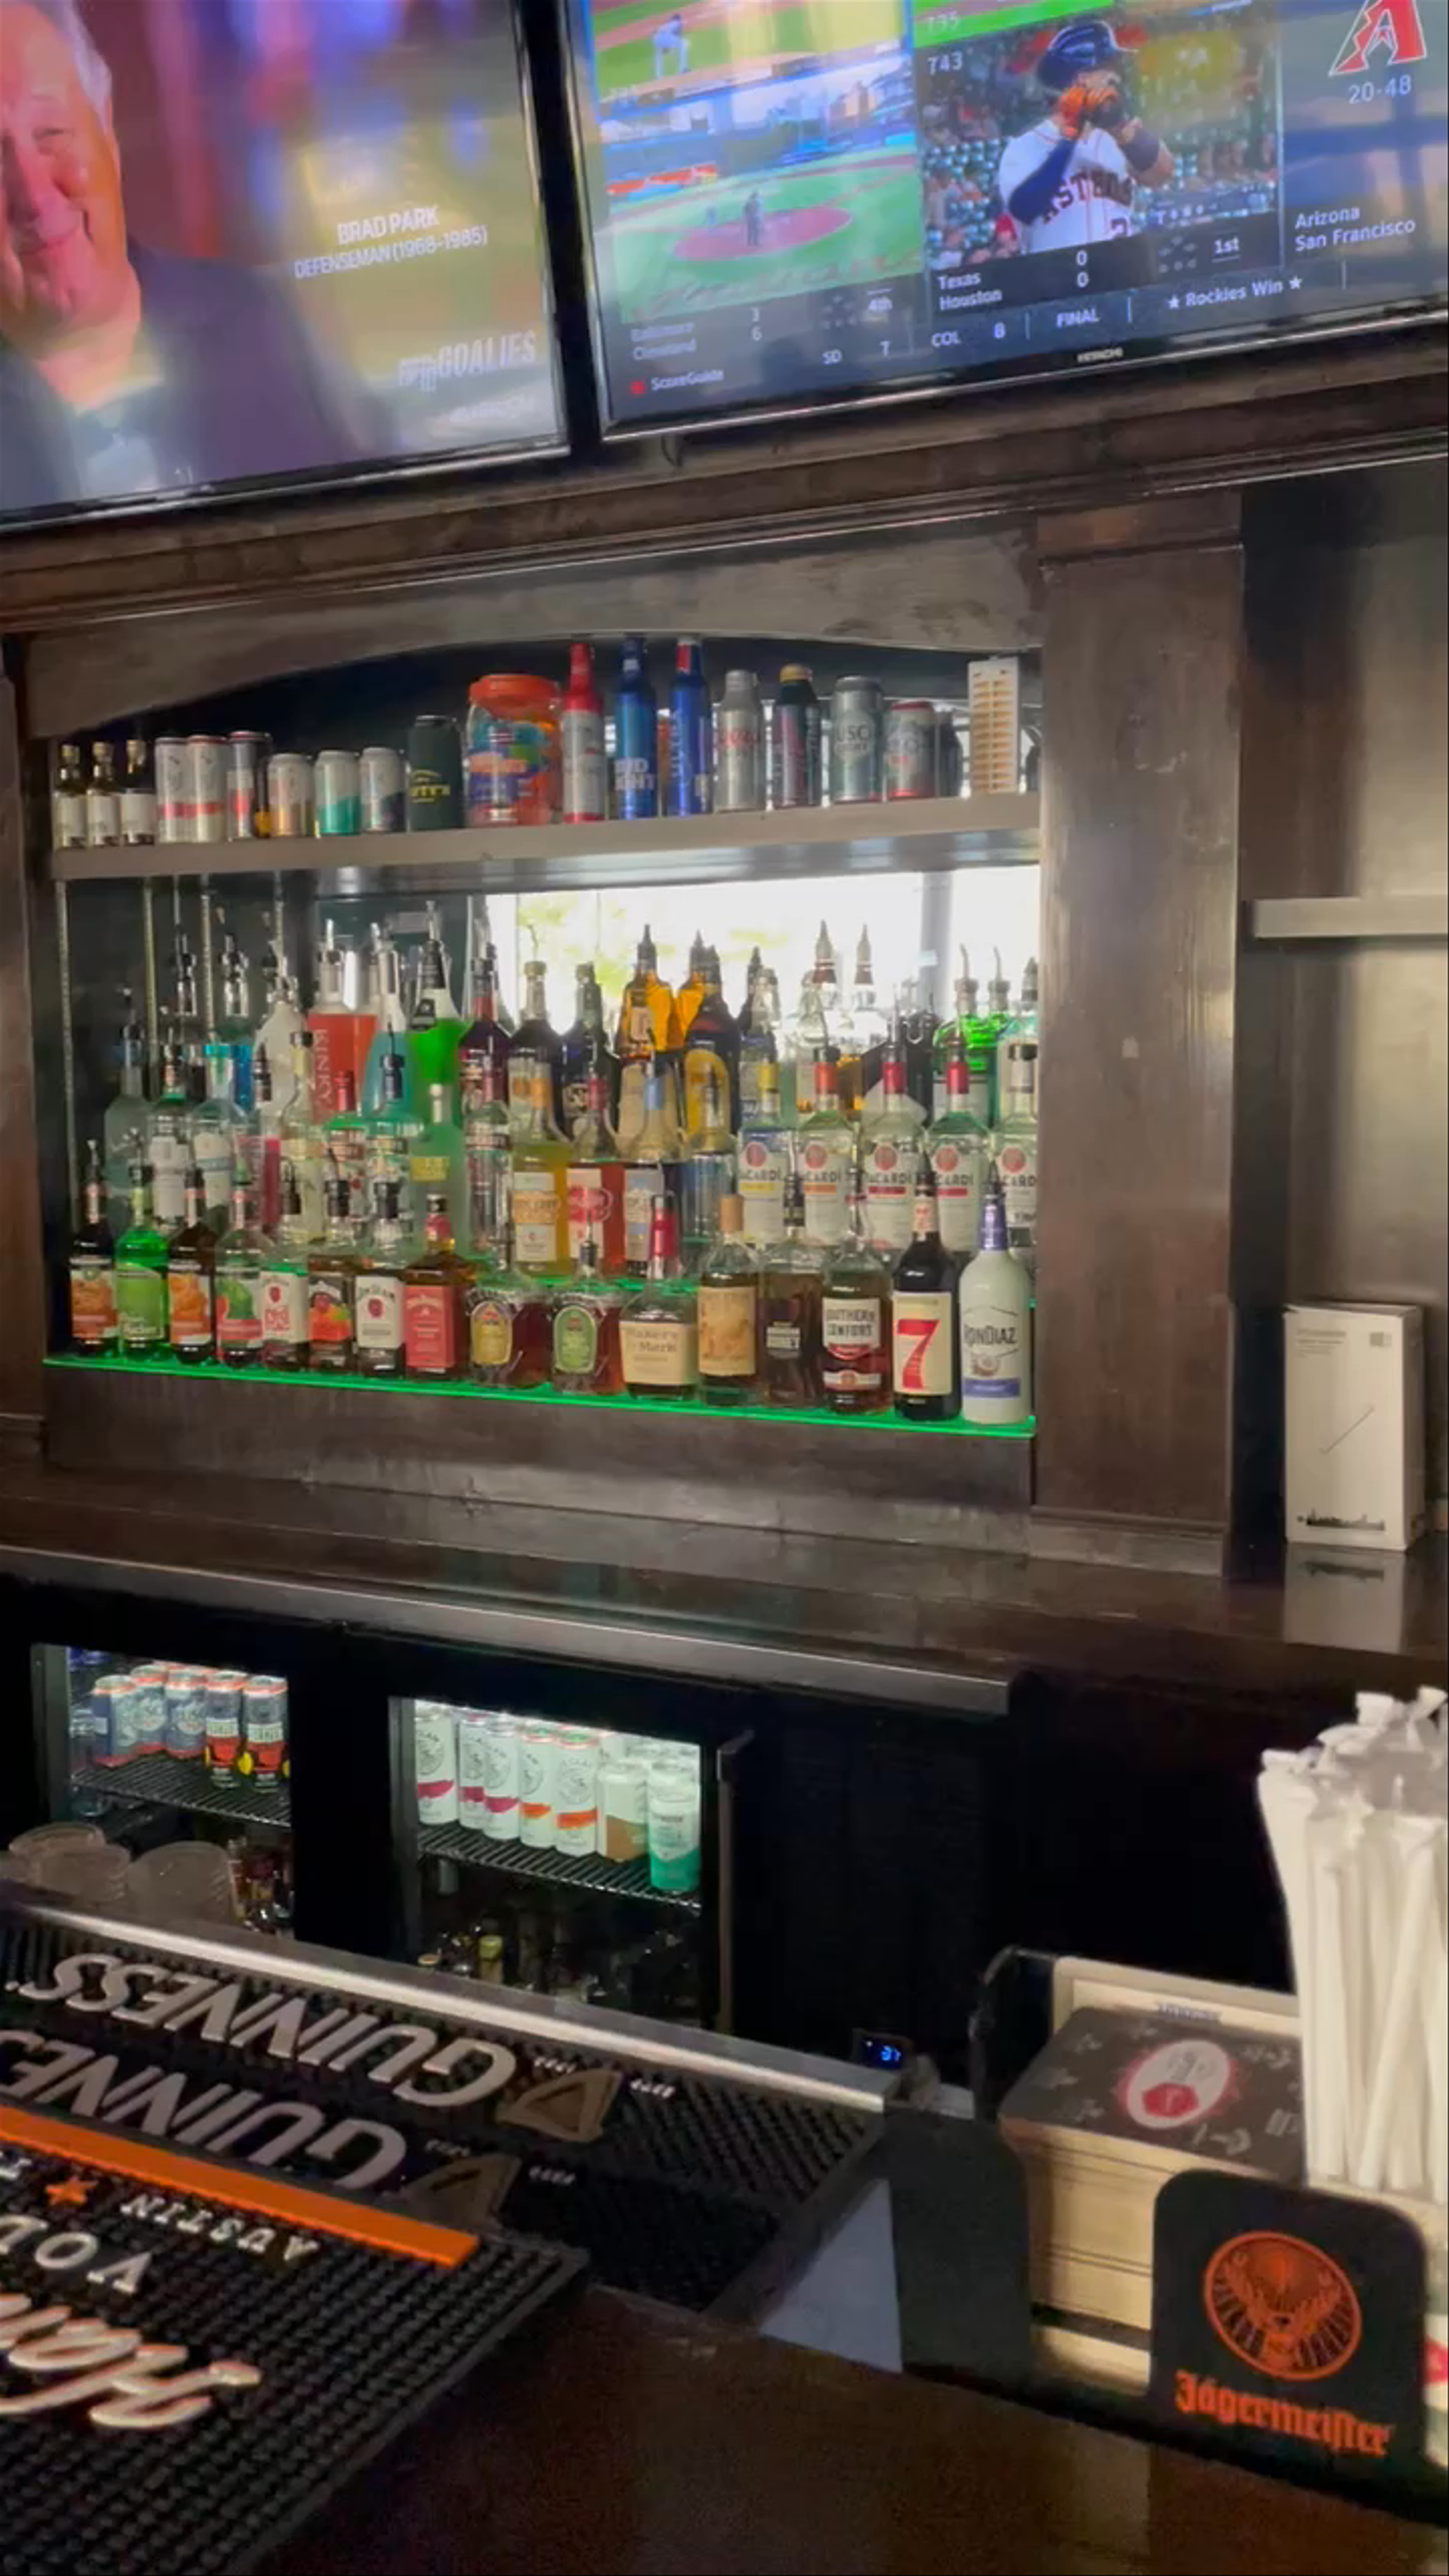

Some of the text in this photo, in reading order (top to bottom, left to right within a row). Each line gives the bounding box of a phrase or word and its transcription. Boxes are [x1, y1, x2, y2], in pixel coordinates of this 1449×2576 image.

[926, 50, 963, 76] 743
[337, 205, 440, 245] BRAD PARK
[1295, 207, 1360, 229] Arizona
[1214, 237, 1240, 255] 1st
[1295, 218, 1416, 252] San Francisco
[294, 225, 488, 278] DEFENSEMAN (1968-1985)
[937, 250, 1087, 290] Texas 0
[940, 271, 1089, 311] Houston 0
[1186, 278, 1283, 307] Rockies Win
[752, 326, 763, 341] 6
[1057, 308, 1100, 328] FINAL
[438, 329, 536, 378] GOALIES
[931, 331, 961, 348] COL
[822, 348, 843, 366] SD
[896, 1318, 941, 1389] 7
[120, 2193, 321, 2262] AUSTIN
